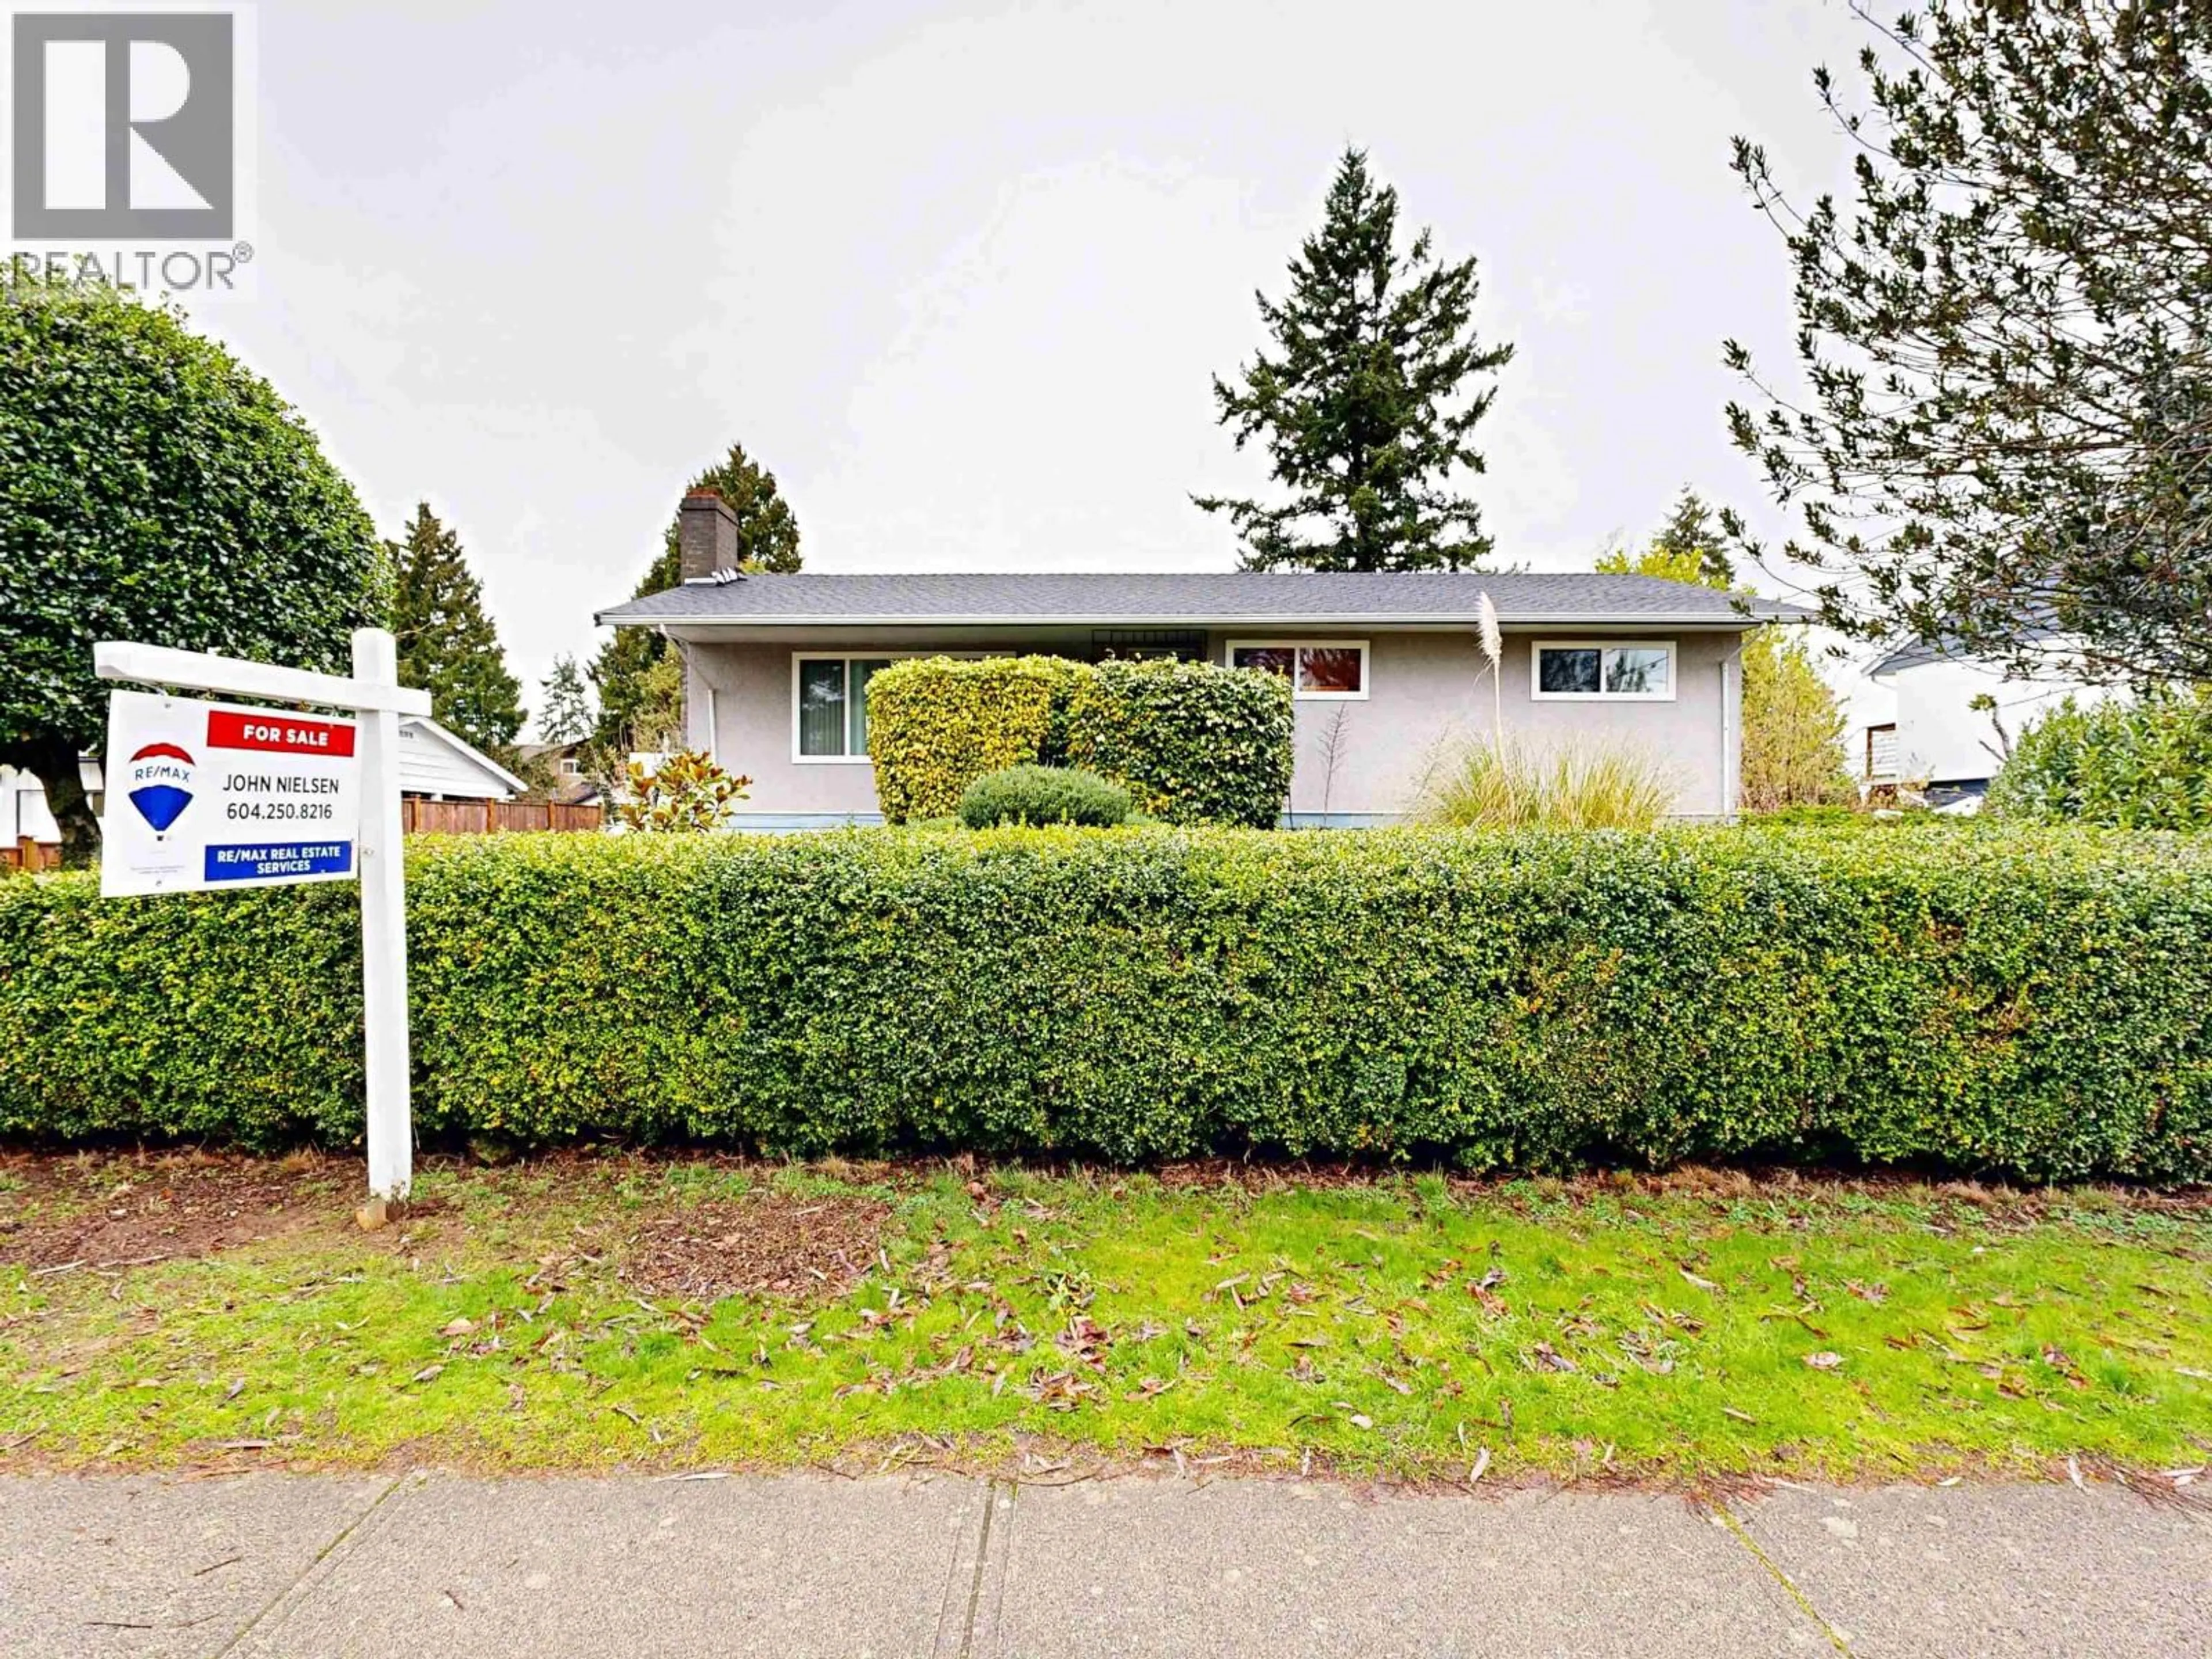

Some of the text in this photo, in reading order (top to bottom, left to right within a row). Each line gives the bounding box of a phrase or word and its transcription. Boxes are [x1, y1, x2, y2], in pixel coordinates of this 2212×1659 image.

[243, 725, 328, 747] FOR SALE
[135, 765, 190, 783] RE/MAX
[222, 774, 339, 794] JOHN NIELSEN
[227, 802, 333, 820] 604.250.8216
[217, 846, 340, 863] RE/MAX REAL ESTATE
[257, 860, 310, 874] SERVICES
